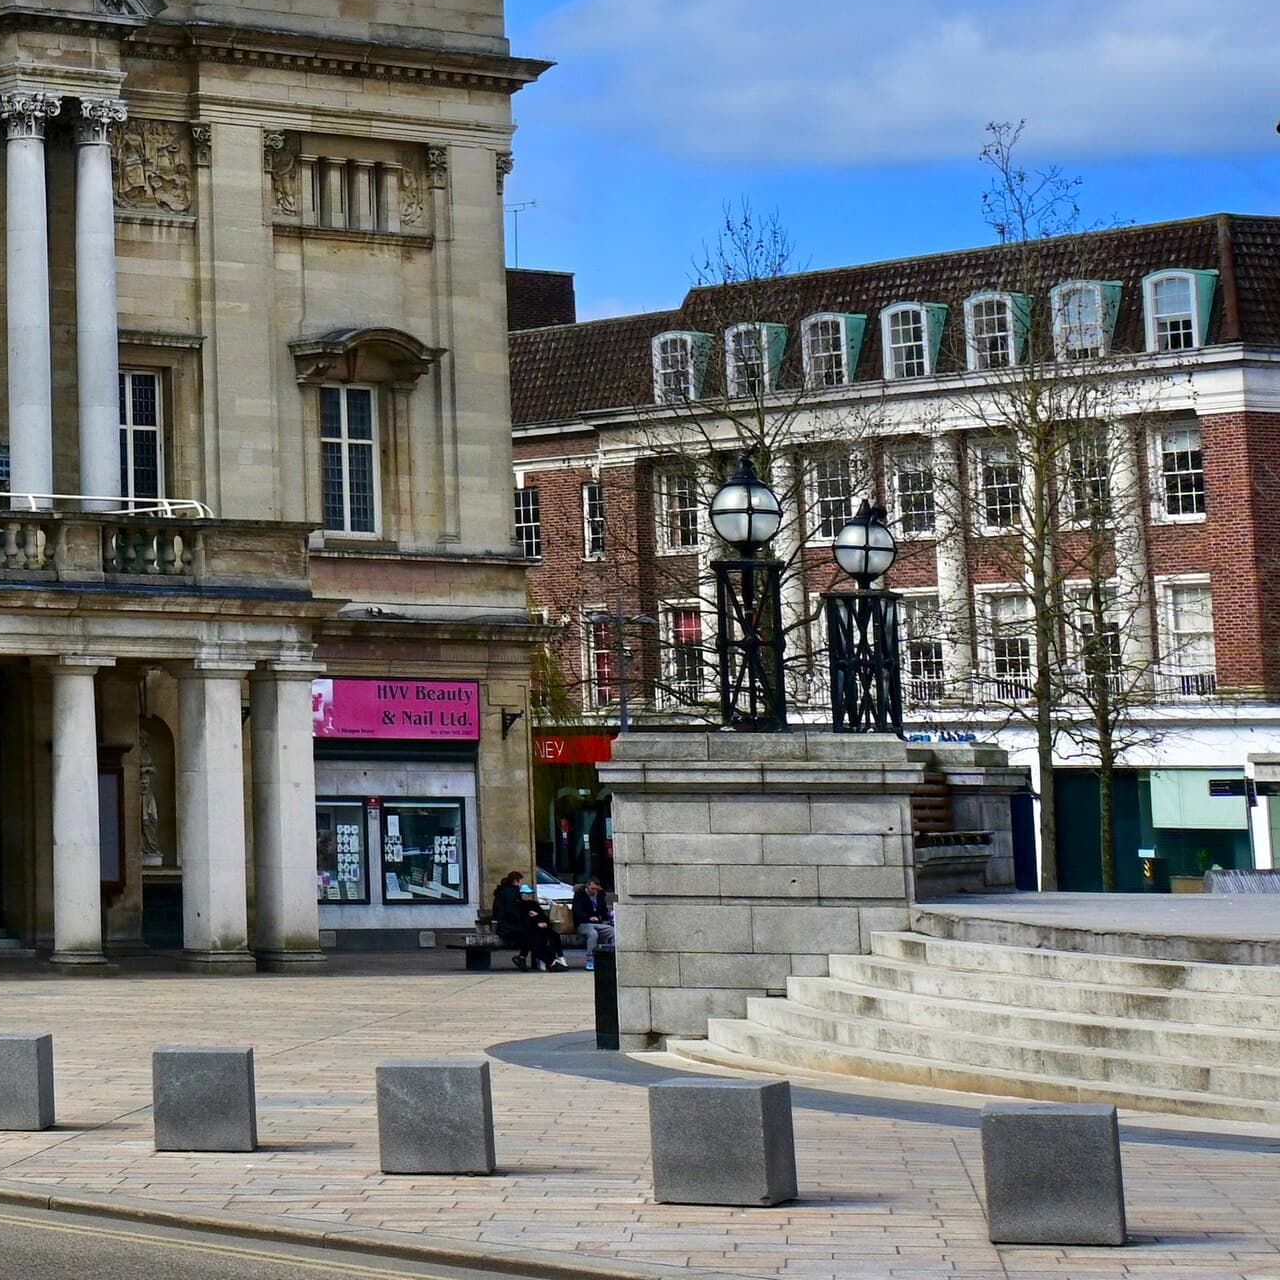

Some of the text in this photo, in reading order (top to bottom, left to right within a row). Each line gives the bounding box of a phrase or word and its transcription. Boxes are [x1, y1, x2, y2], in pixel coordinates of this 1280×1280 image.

[415, 685, 473, 706] Beauty
[383, 710, 473, 727] & Nail Ltd.
[534, 740, 565, 759] NEY
